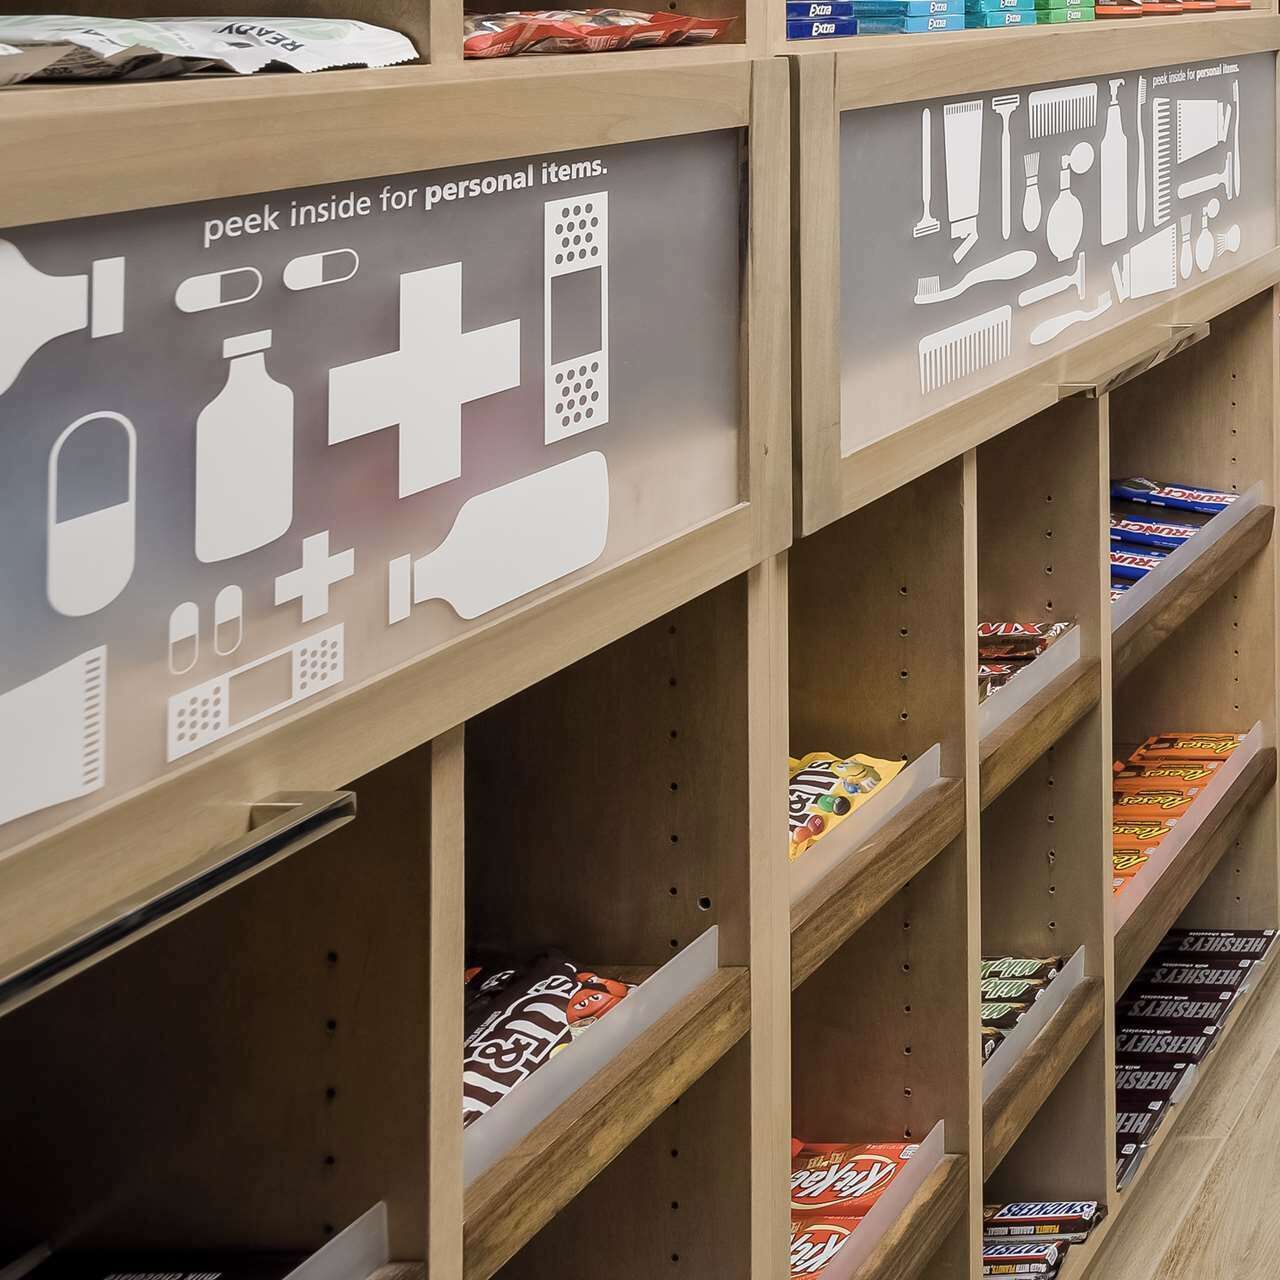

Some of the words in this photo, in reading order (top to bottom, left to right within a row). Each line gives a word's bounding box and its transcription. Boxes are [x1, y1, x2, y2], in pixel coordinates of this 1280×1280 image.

[809, 3, 832, 17] Extra
[812, 22, 836, 36] Extra
[203, 203, 280, 248] peek
[289, 191, 372, 227] inside
[379, 185, 419, 212] for
[425, 164, 535, 210] personal
[541, 157, 609, 185] items.
[1000, 1201, 1094, 1215] SNICKERS
